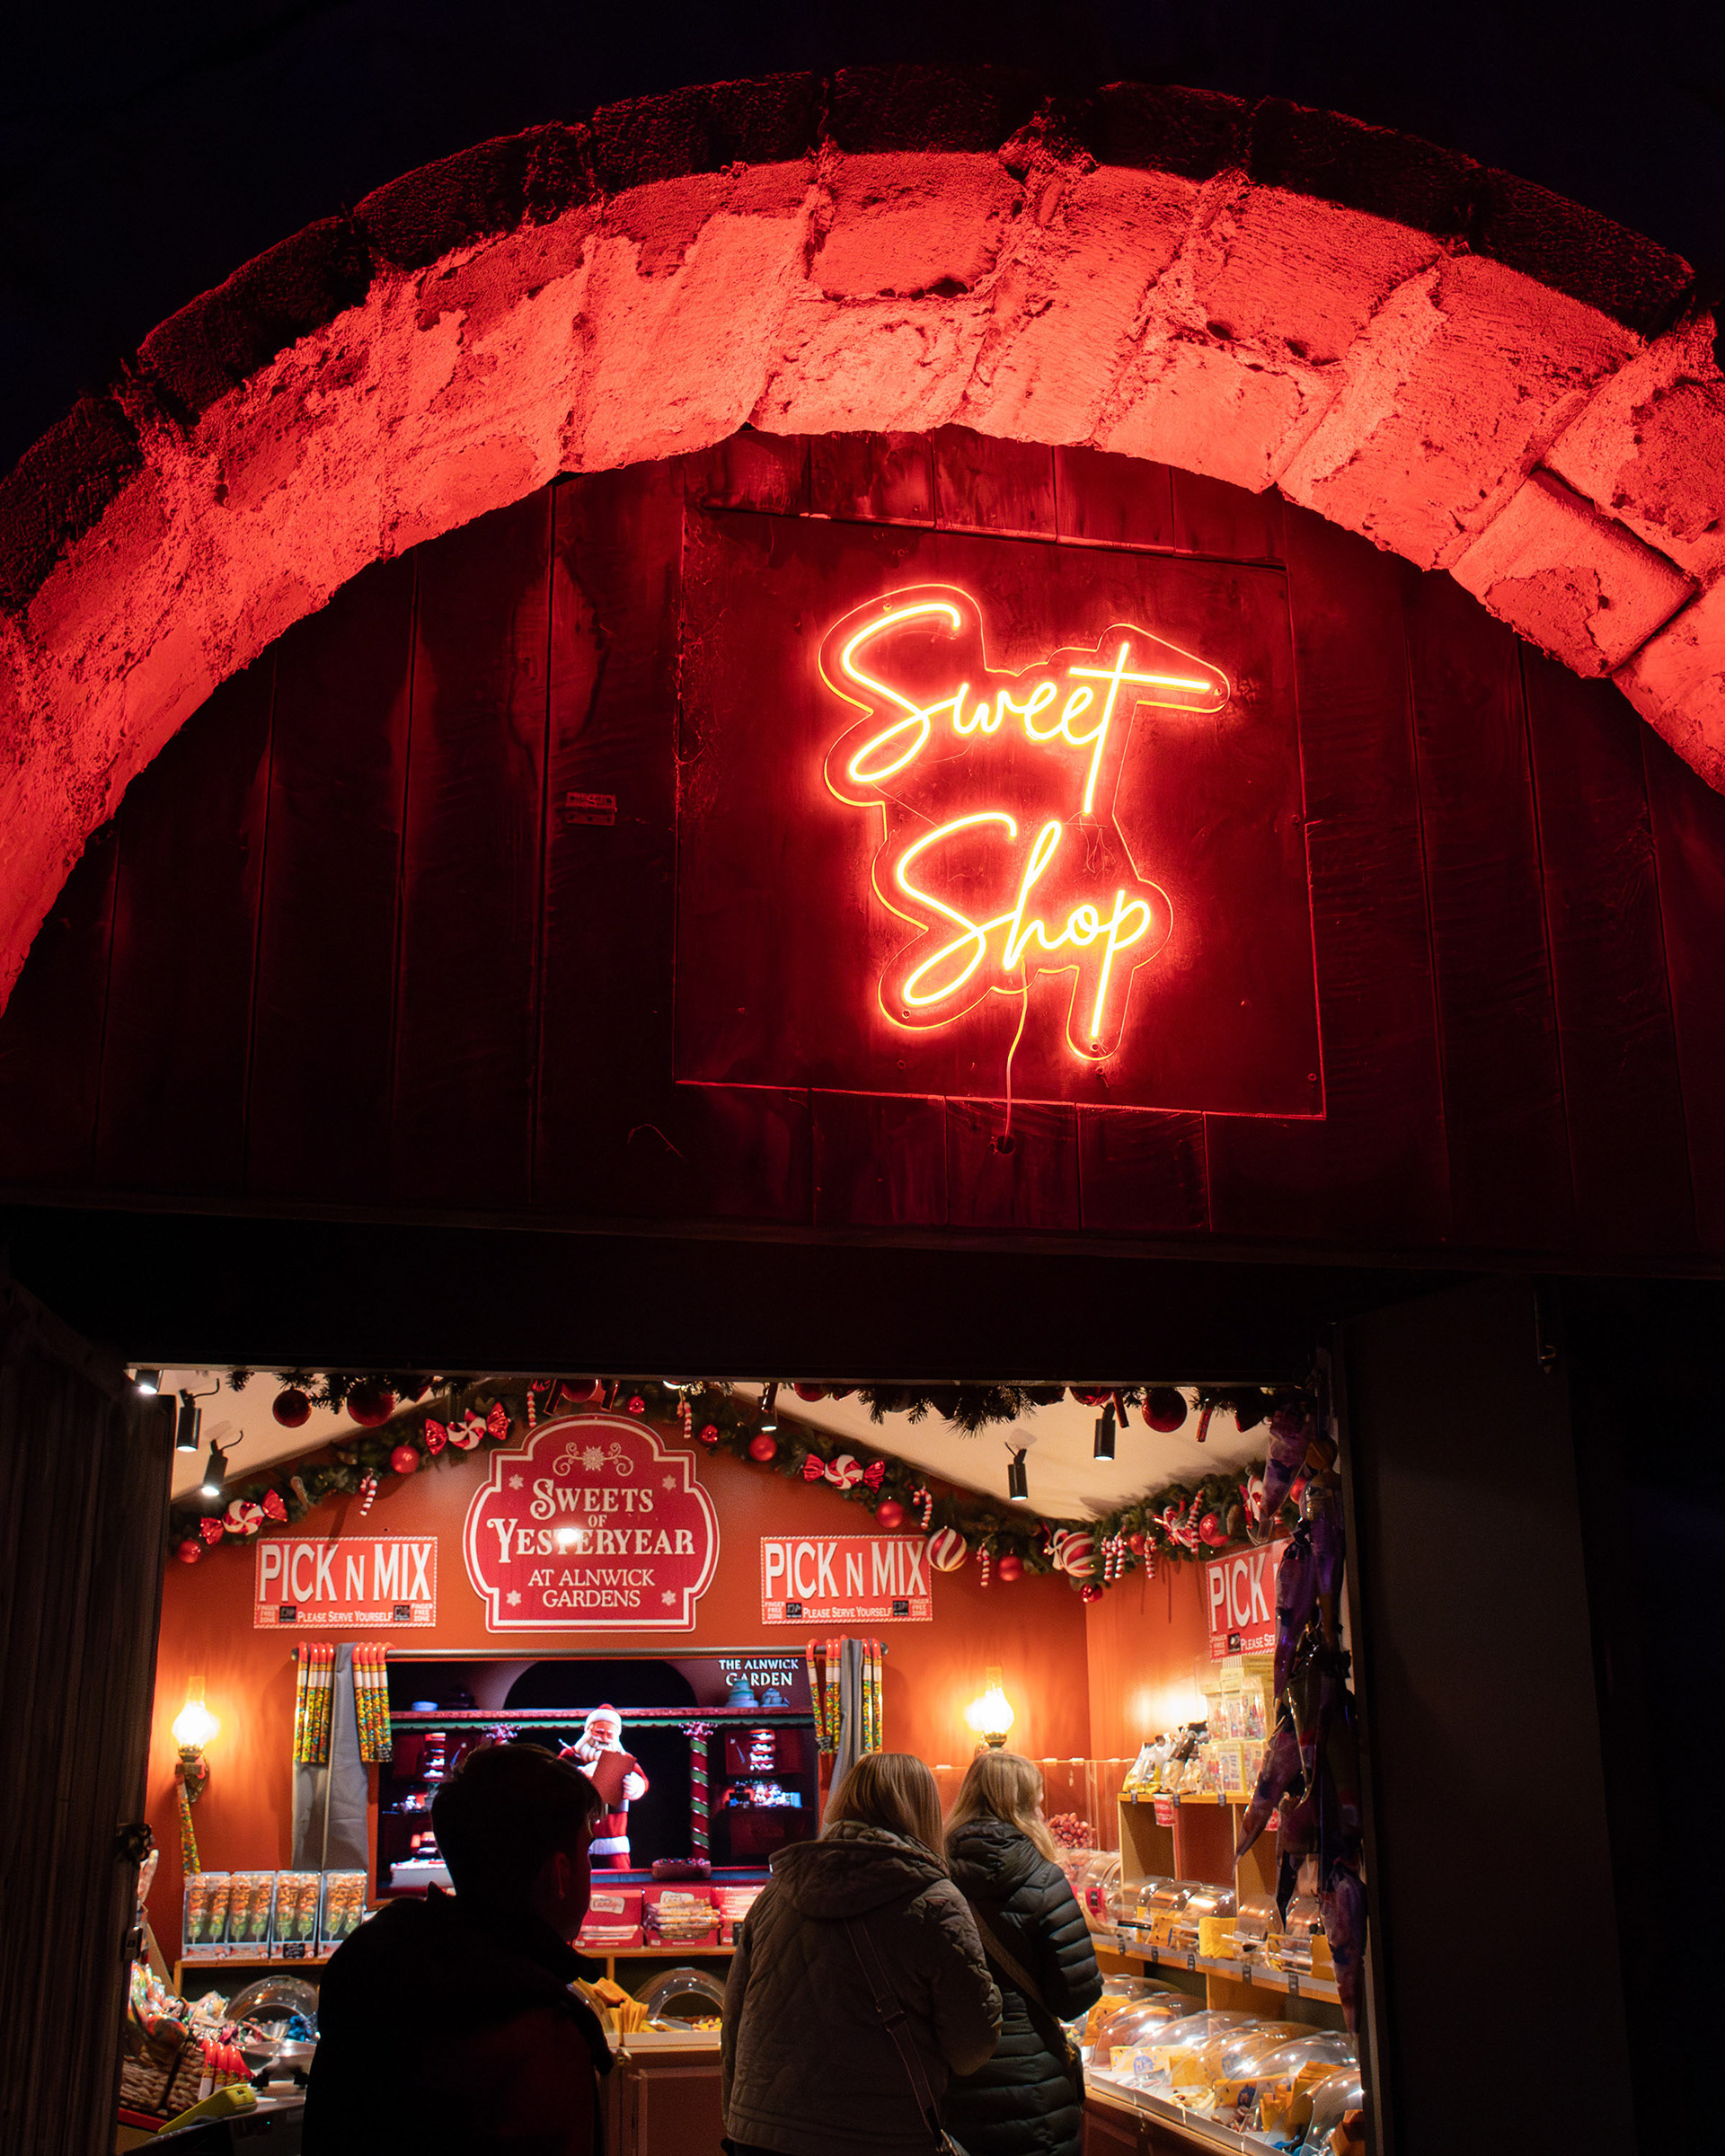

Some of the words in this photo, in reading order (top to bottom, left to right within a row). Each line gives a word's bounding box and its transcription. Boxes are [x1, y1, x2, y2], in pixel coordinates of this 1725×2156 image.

[843, 602, 1211, 815] Sweet
[897, 811, 1153, 1038] Shop
[530, 1479, 654, 1520] SWEETS
[588, 1515, 607, 1527] OF
[259, 1543, 339, 1602] PICK
[345, 1555, 365, 1601] N
[373, 1543, 432, 1601] MIX
[528, 1569, 554, 1586] AT
[559, 1568, 655, 1586] ALNWICK
[765, 1542, 839, 1598] PICK
[845, 1553, 864, 1597] N
[871, 1541, 927, 1596] MIX
[543, 1590, 641, 1607] GARDENS
[1208, 1552, 1270, 1632] PICK
[297, 1611, 327, 1622] PLEASE
[328, 1611, 353, 1622] SERVE
[354, 1611, 394, 1622] YOURSELF
[802, 1606, 830, 1619] PLEASE
[831, 1606, 855, 1618] SERVE
[855, 1606, 892, 1617] YOURSELF
[1240, 1637, 1264, 1651] PLEASE
[719, 1659, 741, 1670] THE
[744, 1658, 799, 1670] ALNWICK
